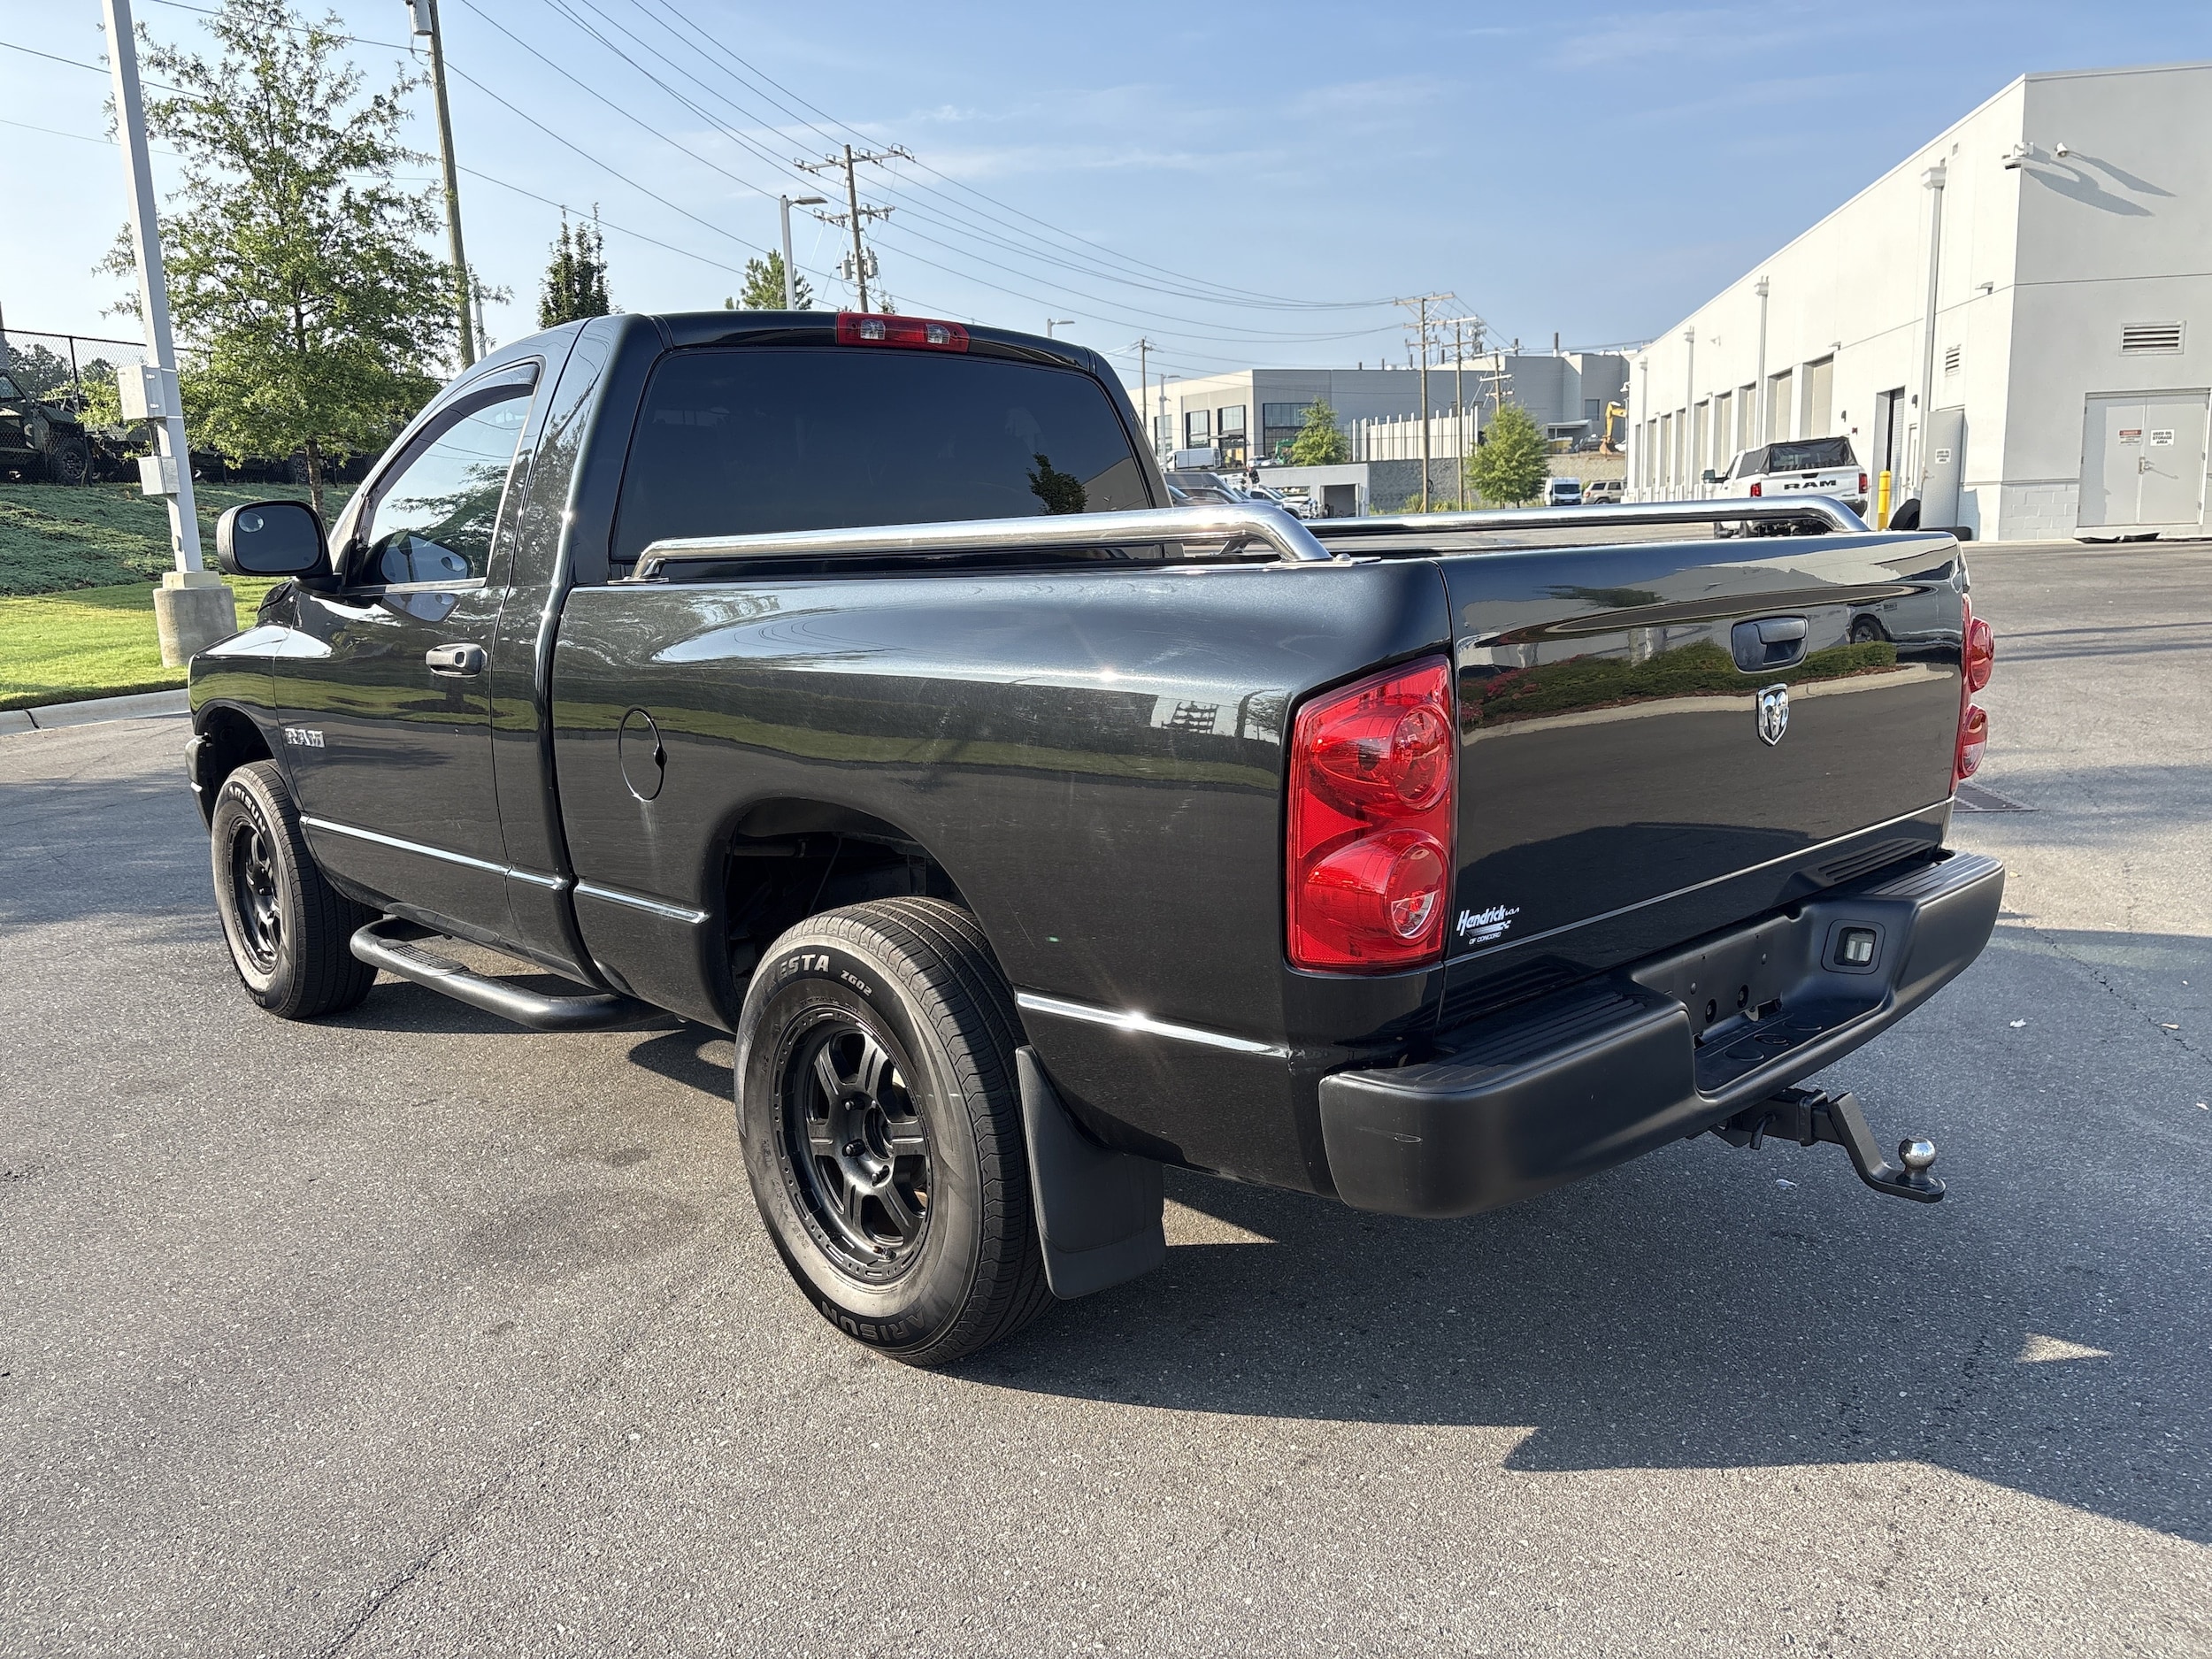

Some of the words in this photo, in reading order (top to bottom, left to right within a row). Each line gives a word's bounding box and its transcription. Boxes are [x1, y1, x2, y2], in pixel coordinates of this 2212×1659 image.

[1784, 480, 1837, 490] RAM
[284, 727, 326, 749] RAM
[1456, 904, 1506, 937] Hendrick
[820, 1300, 926, 1342] ARISUN
